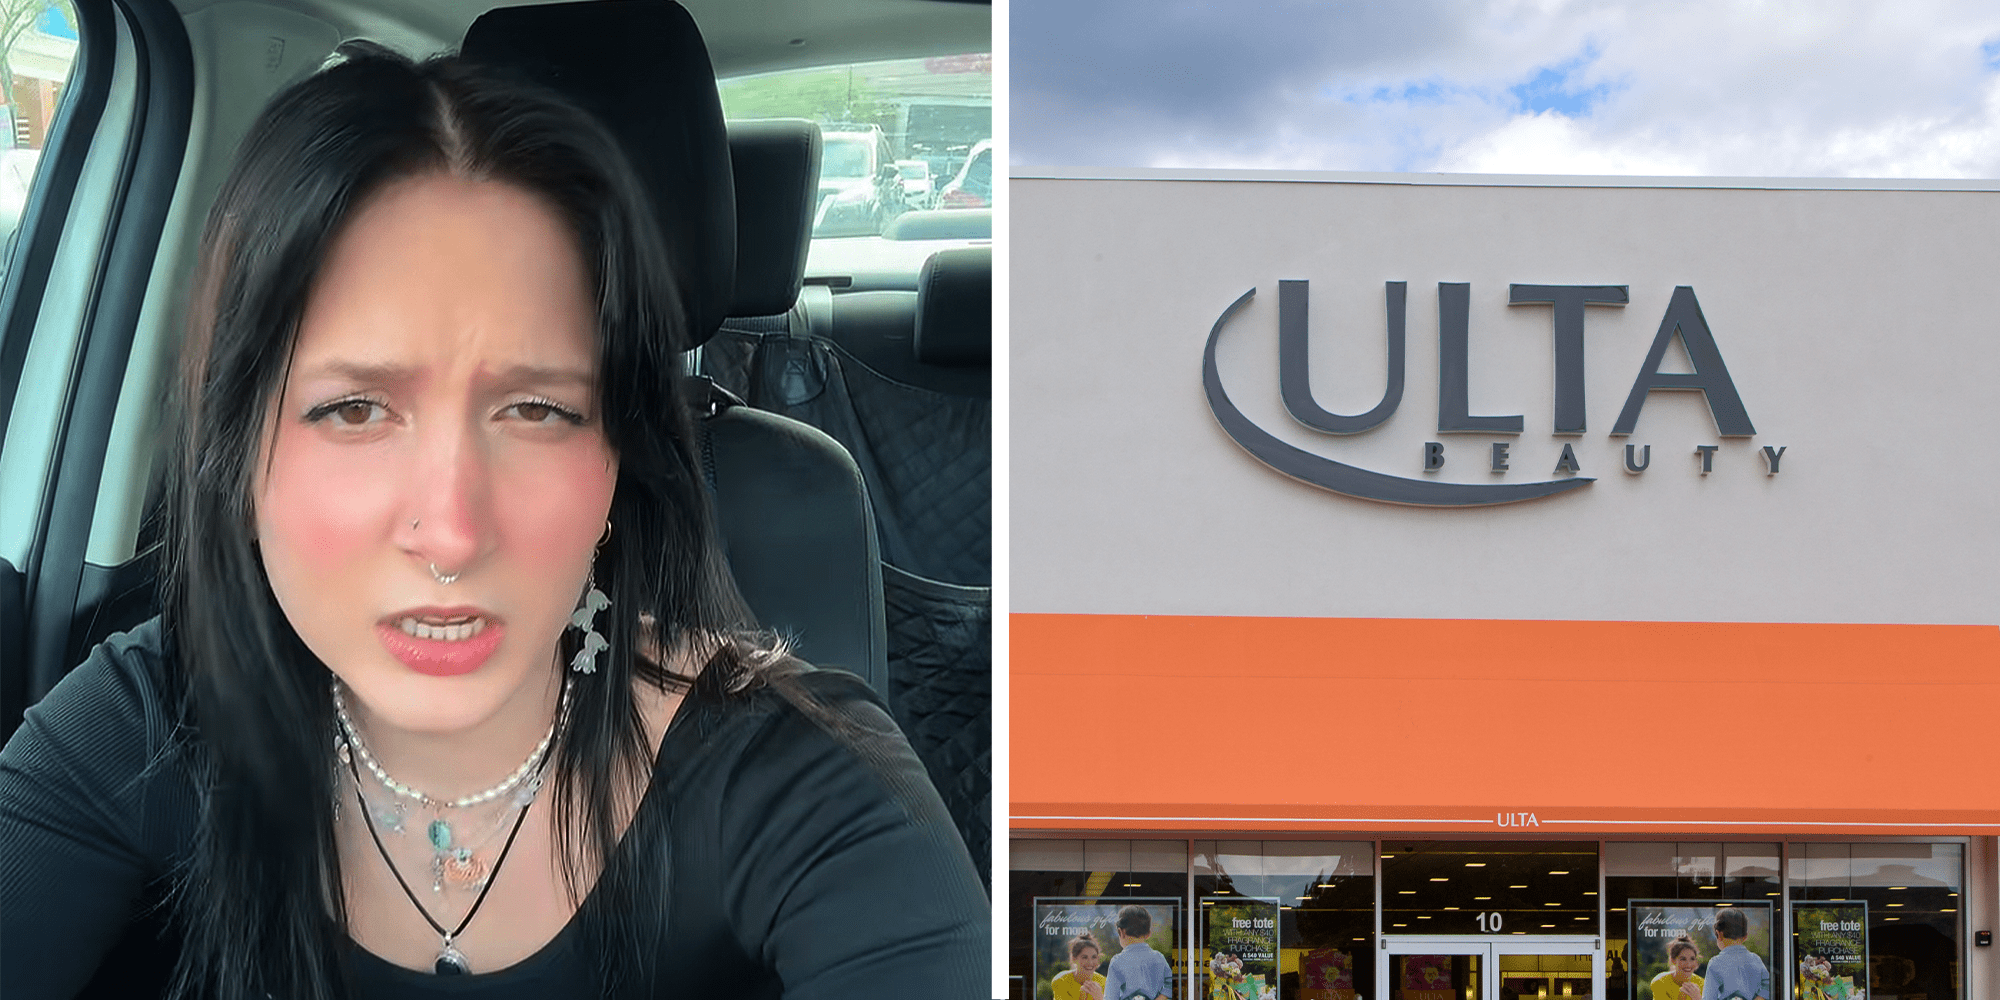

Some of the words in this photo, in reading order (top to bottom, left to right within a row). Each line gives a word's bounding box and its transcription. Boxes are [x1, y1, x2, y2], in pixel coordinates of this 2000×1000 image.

[1278, 279, 1757, 438] ULTA
[1424, 441, 1787, 477] BEAUTY
[1497, 812, 1539, 827] ULTA
[1039, 910, 1091, 928] fabulous
[1089, 910, 1122, 929] gifts
[1232, 917, 1251, 928] free
[1253, 917, 1273, 928] tote
[1476, 911, 1502, 932] 10
[1638, 912, 1689, 930] fabulous
[1687, 913, 1719, 931] gifts
[1820, 920, 1839, 931] free
[1840, 920, 1860, 931] tote
[1045, 924, 1059, 936] for
[1062, 926, 1088, 936] mom
[1644, 926, 1658, 938] for
[1661, 928, 1687, 938] mom
[1227, 936, 1274, 945] FRAGRANCE
[1815, 939, 1861, 947] FRAGRANCE
